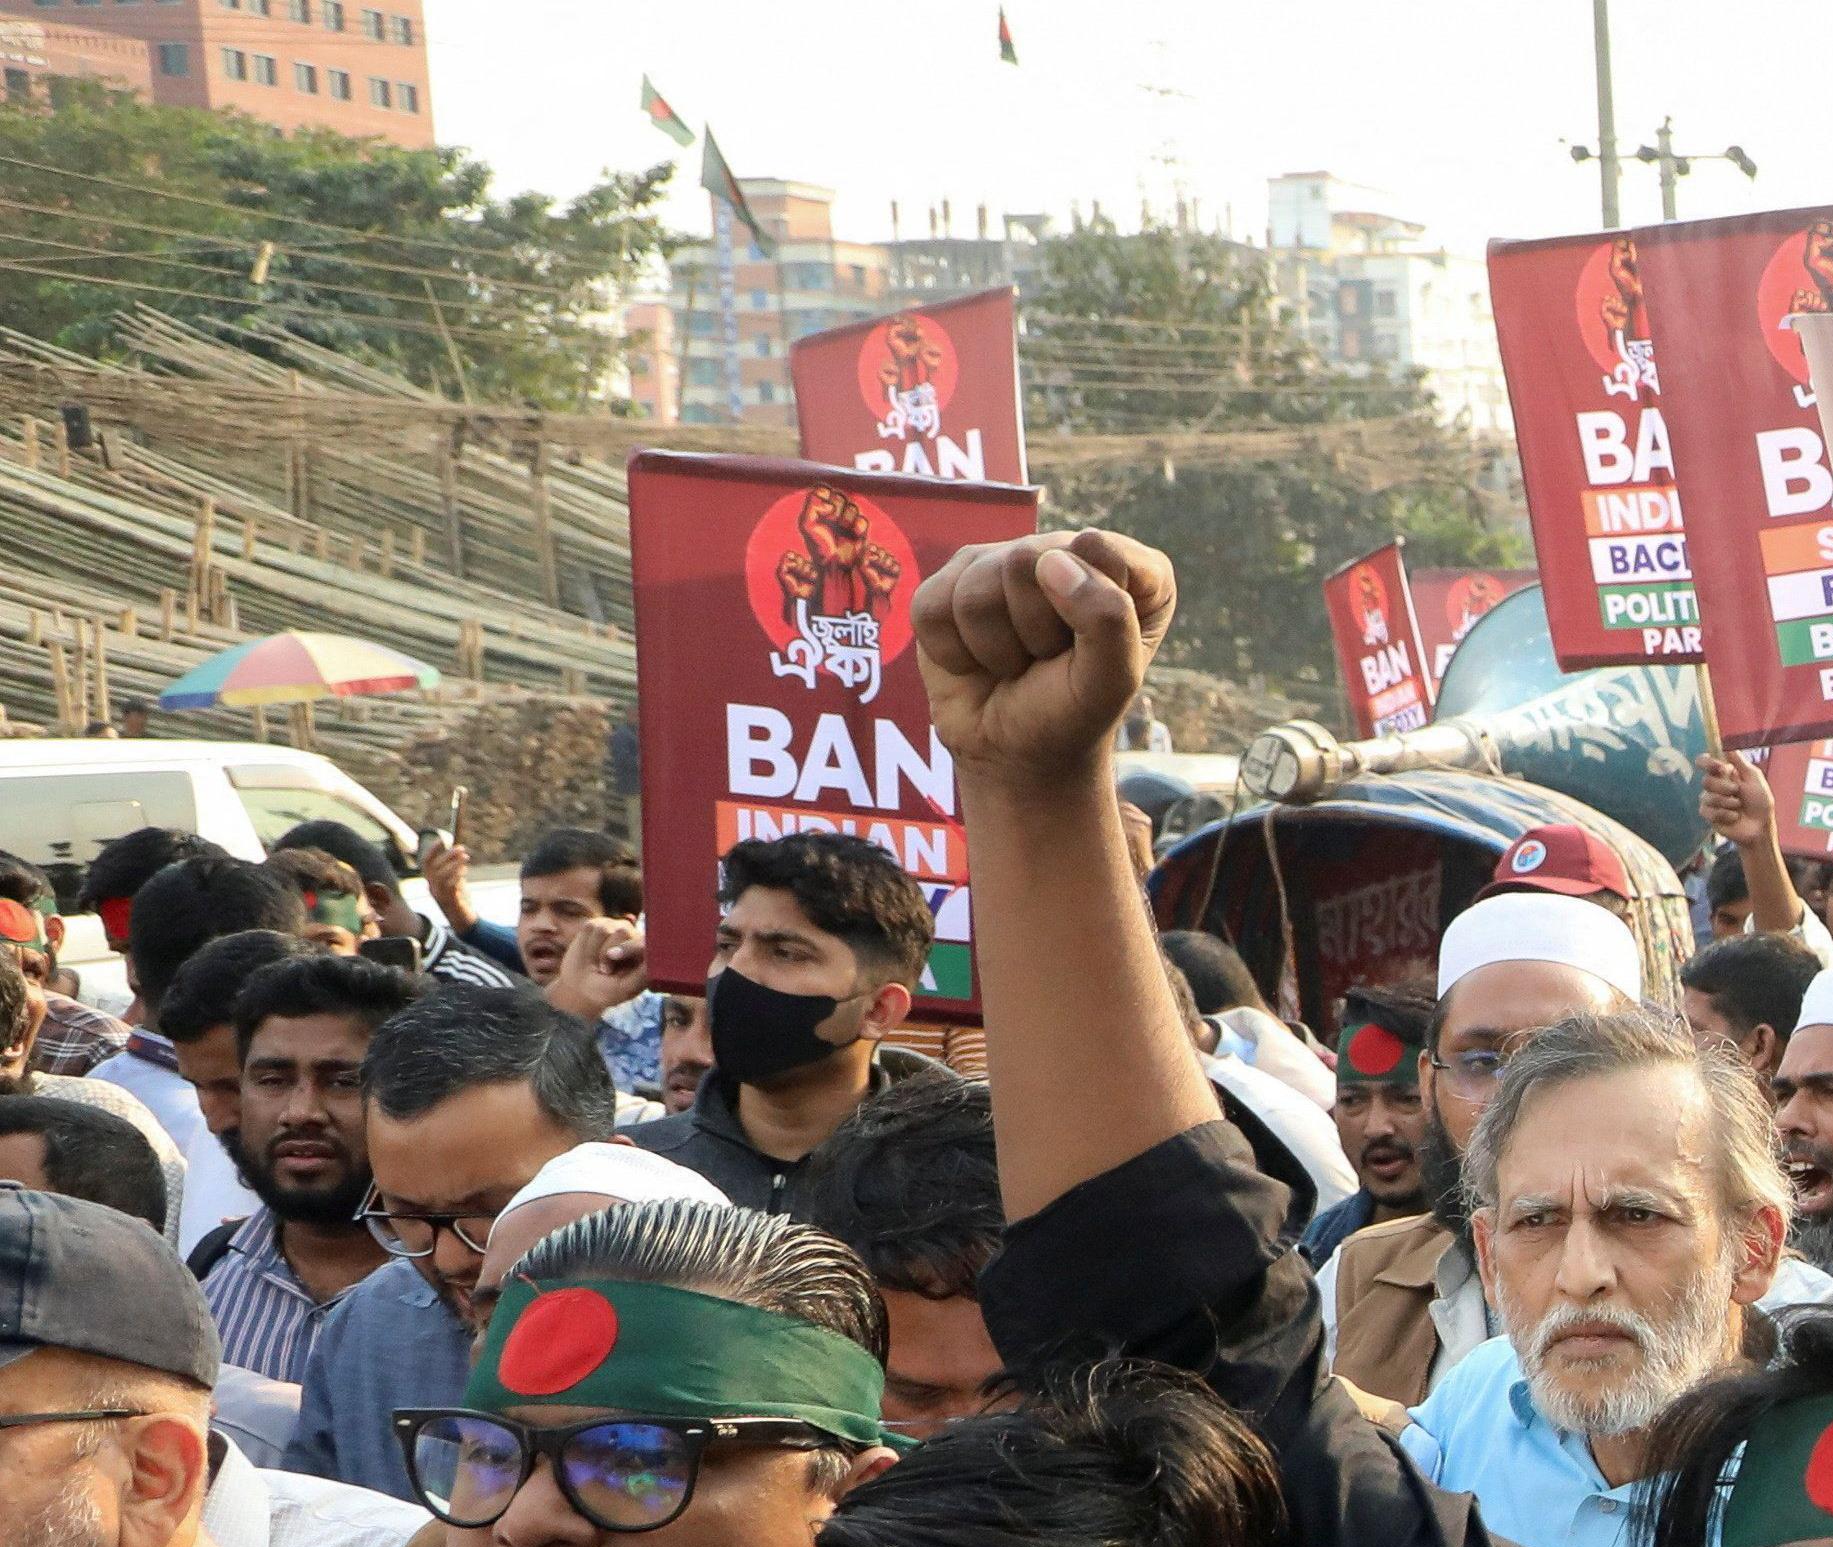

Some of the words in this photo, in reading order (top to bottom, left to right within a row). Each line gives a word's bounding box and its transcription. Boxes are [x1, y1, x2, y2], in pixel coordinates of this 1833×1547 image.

[1576, 407, 1675, 486] BA
[1597, 490, 1684, 532] INDI
[1610, 541, 1690, 575] BAC
[771, 599, 881, 705] ঐক্য
[812, 610, 880, 648] জুলাই
[1643, 628, 1703, 655] PAR
[1360, 640, 1412, 695] BAN
[726, 703, 956, 816] BAN
